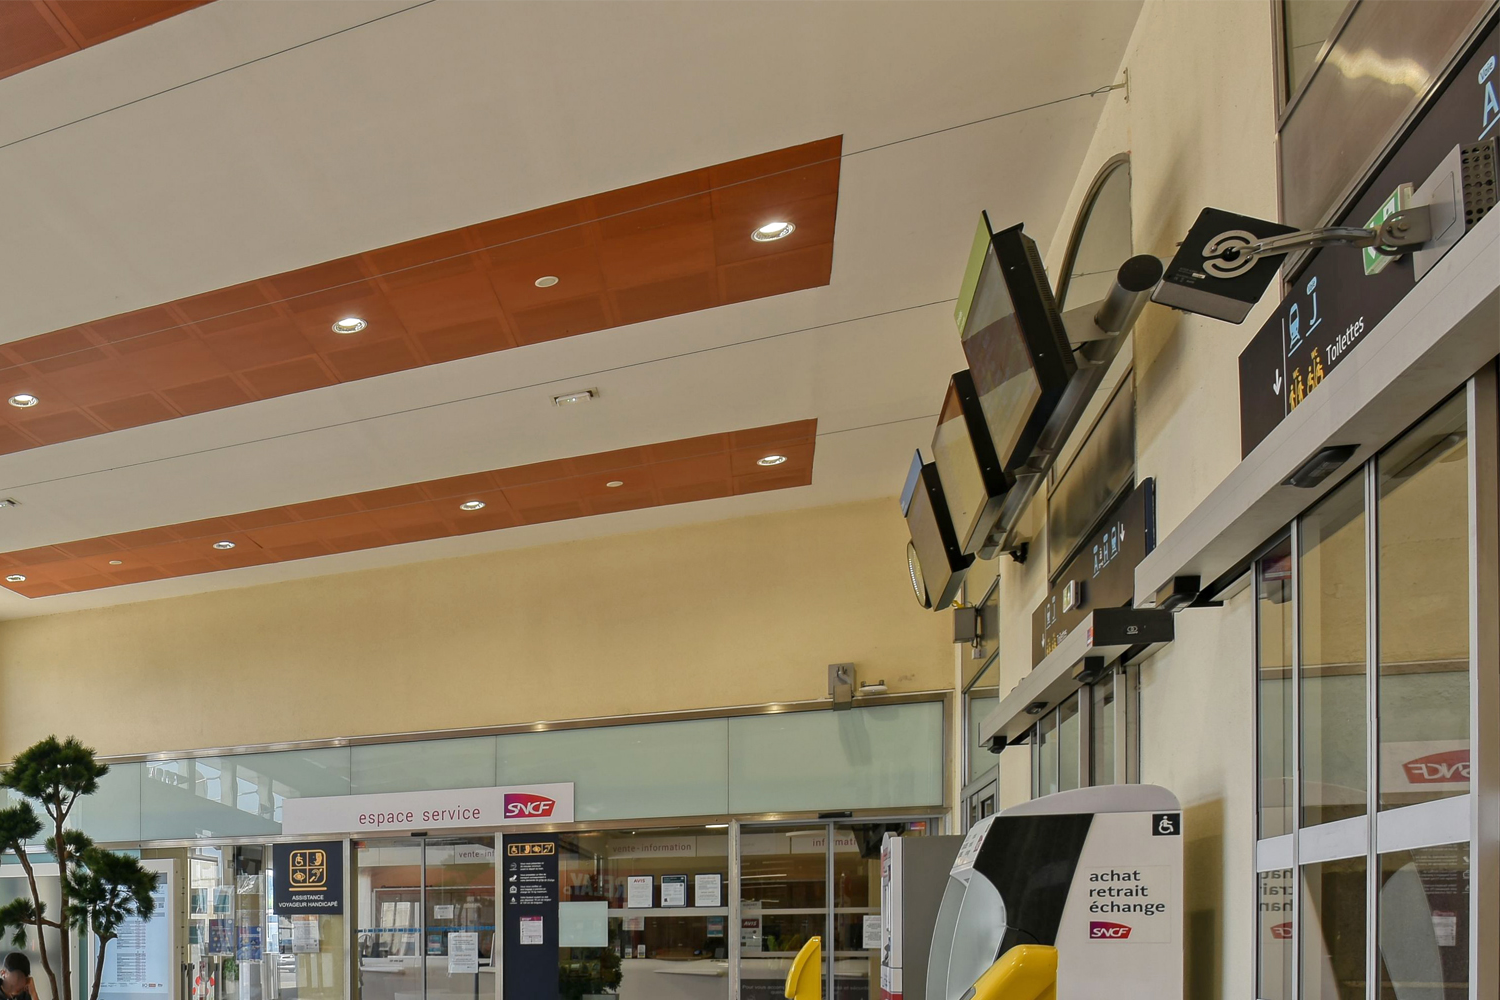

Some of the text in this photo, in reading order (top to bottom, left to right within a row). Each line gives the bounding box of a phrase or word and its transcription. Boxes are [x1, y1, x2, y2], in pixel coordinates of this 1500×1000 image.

[1482, 80, 1499, 128] A
[1309, 291, 1318, 326] J
[1325, 315, 1365, 366] Toilettes
[358, 804, 481, 827] espace service
[505, 800, 553, 816] SNCF
[458, 849, 495, 858] vente-inf
[1089, 869, 1141, 882] achat
[1089, 884, 1149, 898] retrait
[307, 900, 338, 908] HANDICAPÉ
[1089, 900, 1166, 916] échange
[1091, 927, 1130, 938] SNCF
